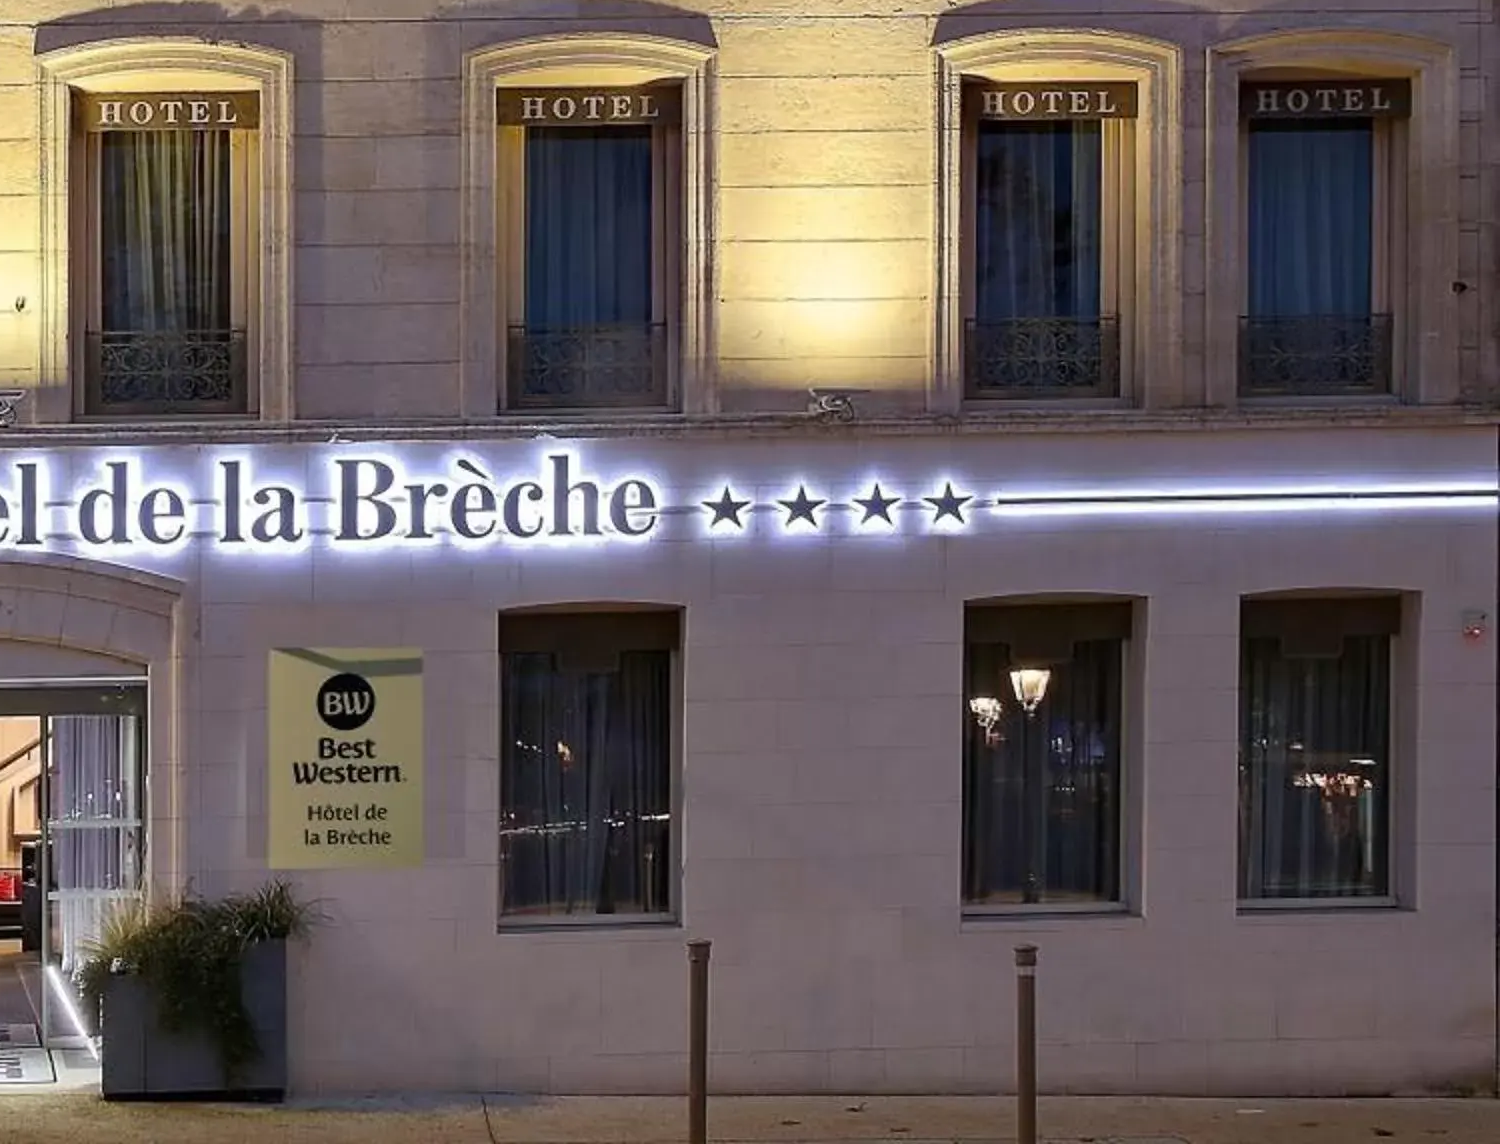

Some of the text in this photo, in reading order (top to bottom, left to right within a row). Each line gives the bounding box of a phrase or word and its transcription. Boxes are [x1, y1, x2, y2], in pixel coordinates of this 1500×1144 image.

[99, 100, 237, 125] HOTEL
[522, 95, 660, 119] HOTEL
[982, 91, 1117, 115] HOTEL
[1257, 89, 1391, 113] HOTEL
[78, 461, 186, 545] de
[219, 460, 303, 543] la
[335, 454, 657, 541] Brèche
[323, 690, 370, 716] BW
[318, 737, 376, 760] Best
[293, 761, 401, 785] Western
[307, 803, 388, 822] Hôtel de
[304, 828, 392, 846] la Brèche
